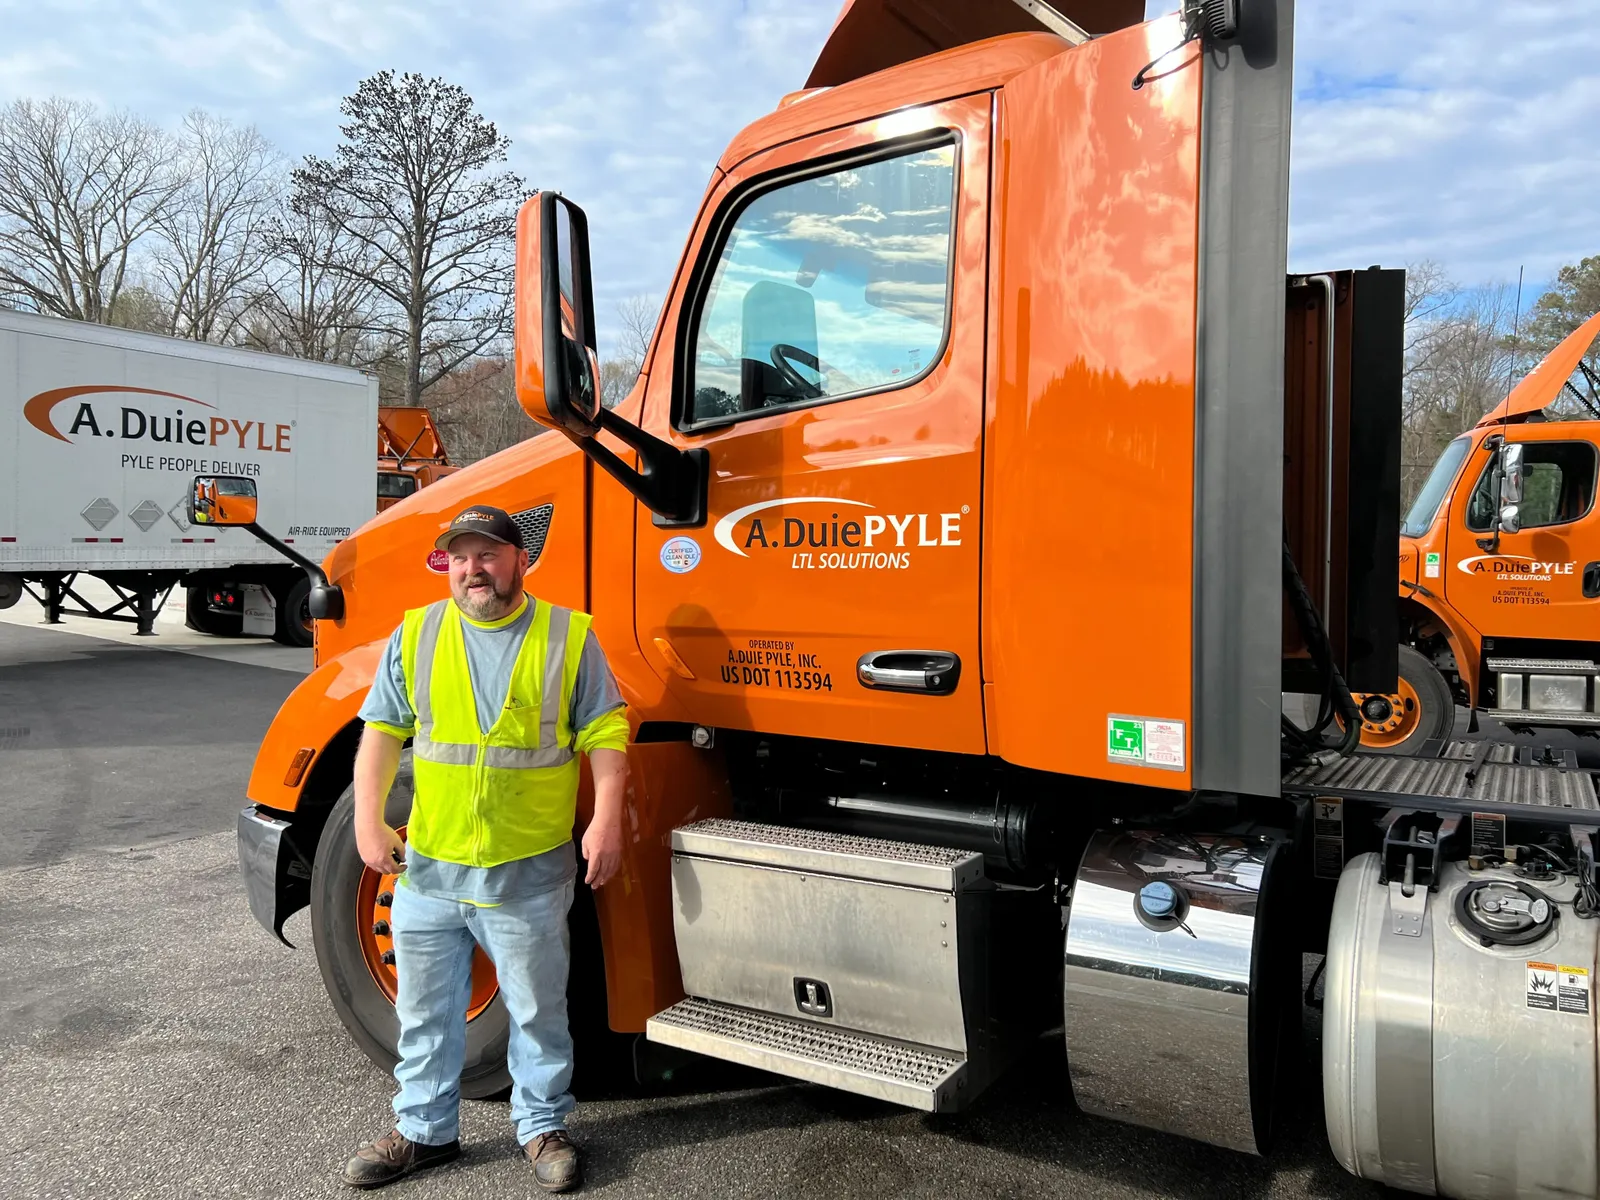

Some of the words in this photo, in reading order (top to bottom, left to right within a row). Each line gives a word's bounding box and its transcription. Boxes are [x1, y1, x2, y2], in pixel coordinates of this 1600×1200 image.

[121, 454, 154, 470] PYLE
[159, 456, 208, 473] PEOPLE
[212, 460, 261, 476] DELIVER
[288, 526, 318, 536] AIR-RIDE
[319, 526, 351, 536] EQUIPPED
[791, 552, 814, 569] LTL
[818, 551, 910, 569] SOLUTIONS
[1521, 597, 1550, 605] 113594
[749, 639, 784, 650] OPERATED
[785, 641, 794, 650] BY
[728, 650, 763, 665] A.DUIE
[720, 665, 740, 684] US
[742, 667, 770, 686] DOT
[775, 669, 832, 691] 113594
